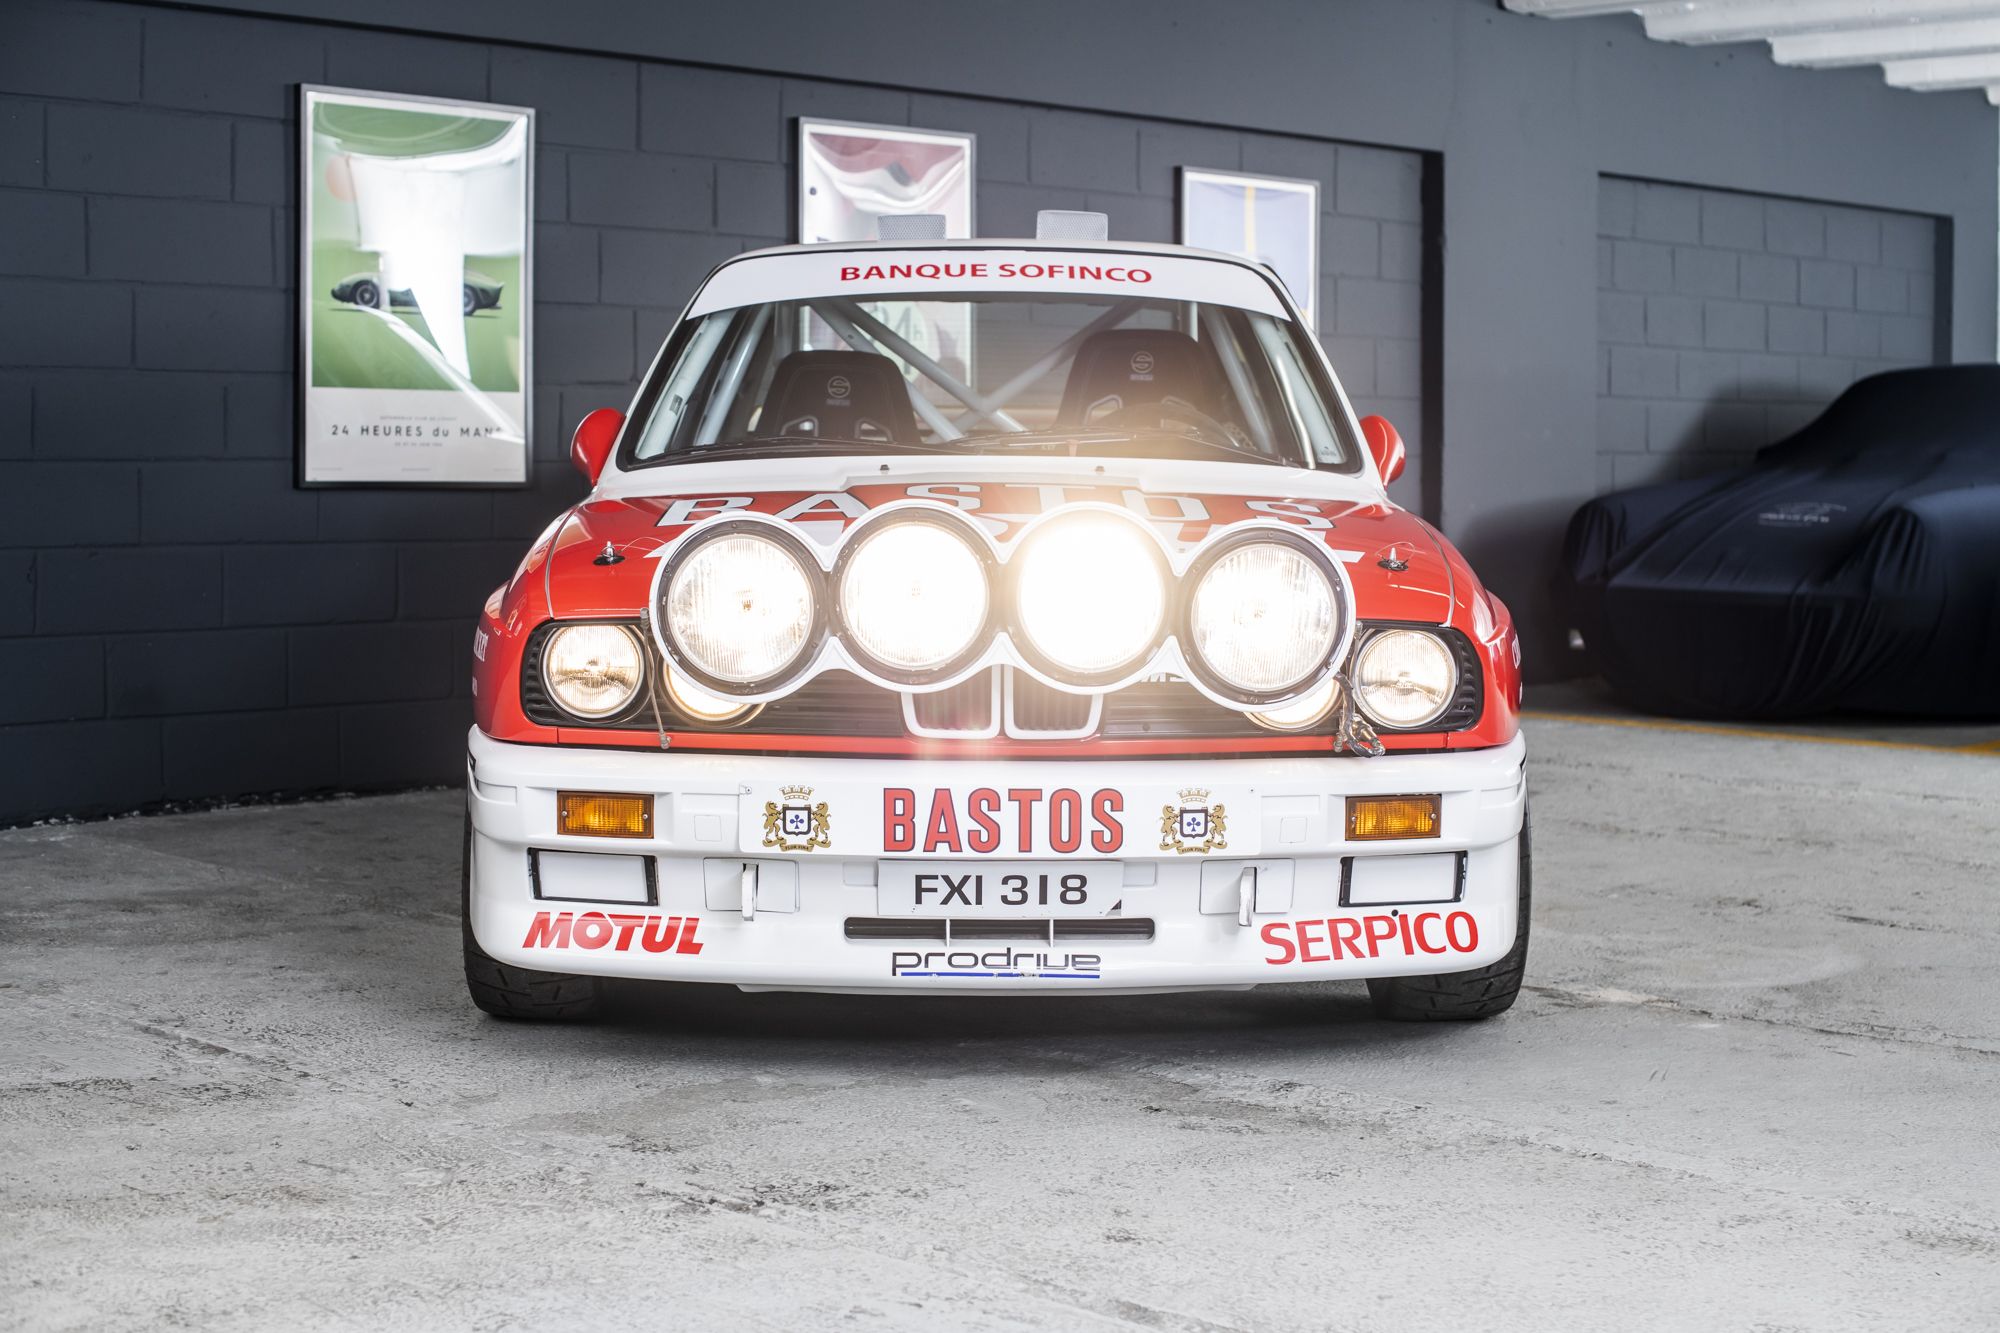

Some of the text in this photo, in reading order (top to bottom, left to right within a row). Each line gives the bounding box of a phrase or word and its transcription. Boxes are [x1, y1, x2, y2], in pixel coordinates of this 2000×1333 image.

[840, 263, 1152, 283] BANQUE SOFINCO
[331, 424, 350, 436] 24
[360, 425, 423, 437] HEURES
[432, 426, 450, 437] du
[883, 787, 1124, 853] BASTOS
[1000, 874, 1088, 906] 318
[521, 911, 704, 955] MOTUL
[1260, 910, 1479, 966] SERPICO
[892, 947, 1102, 976] prodrive
